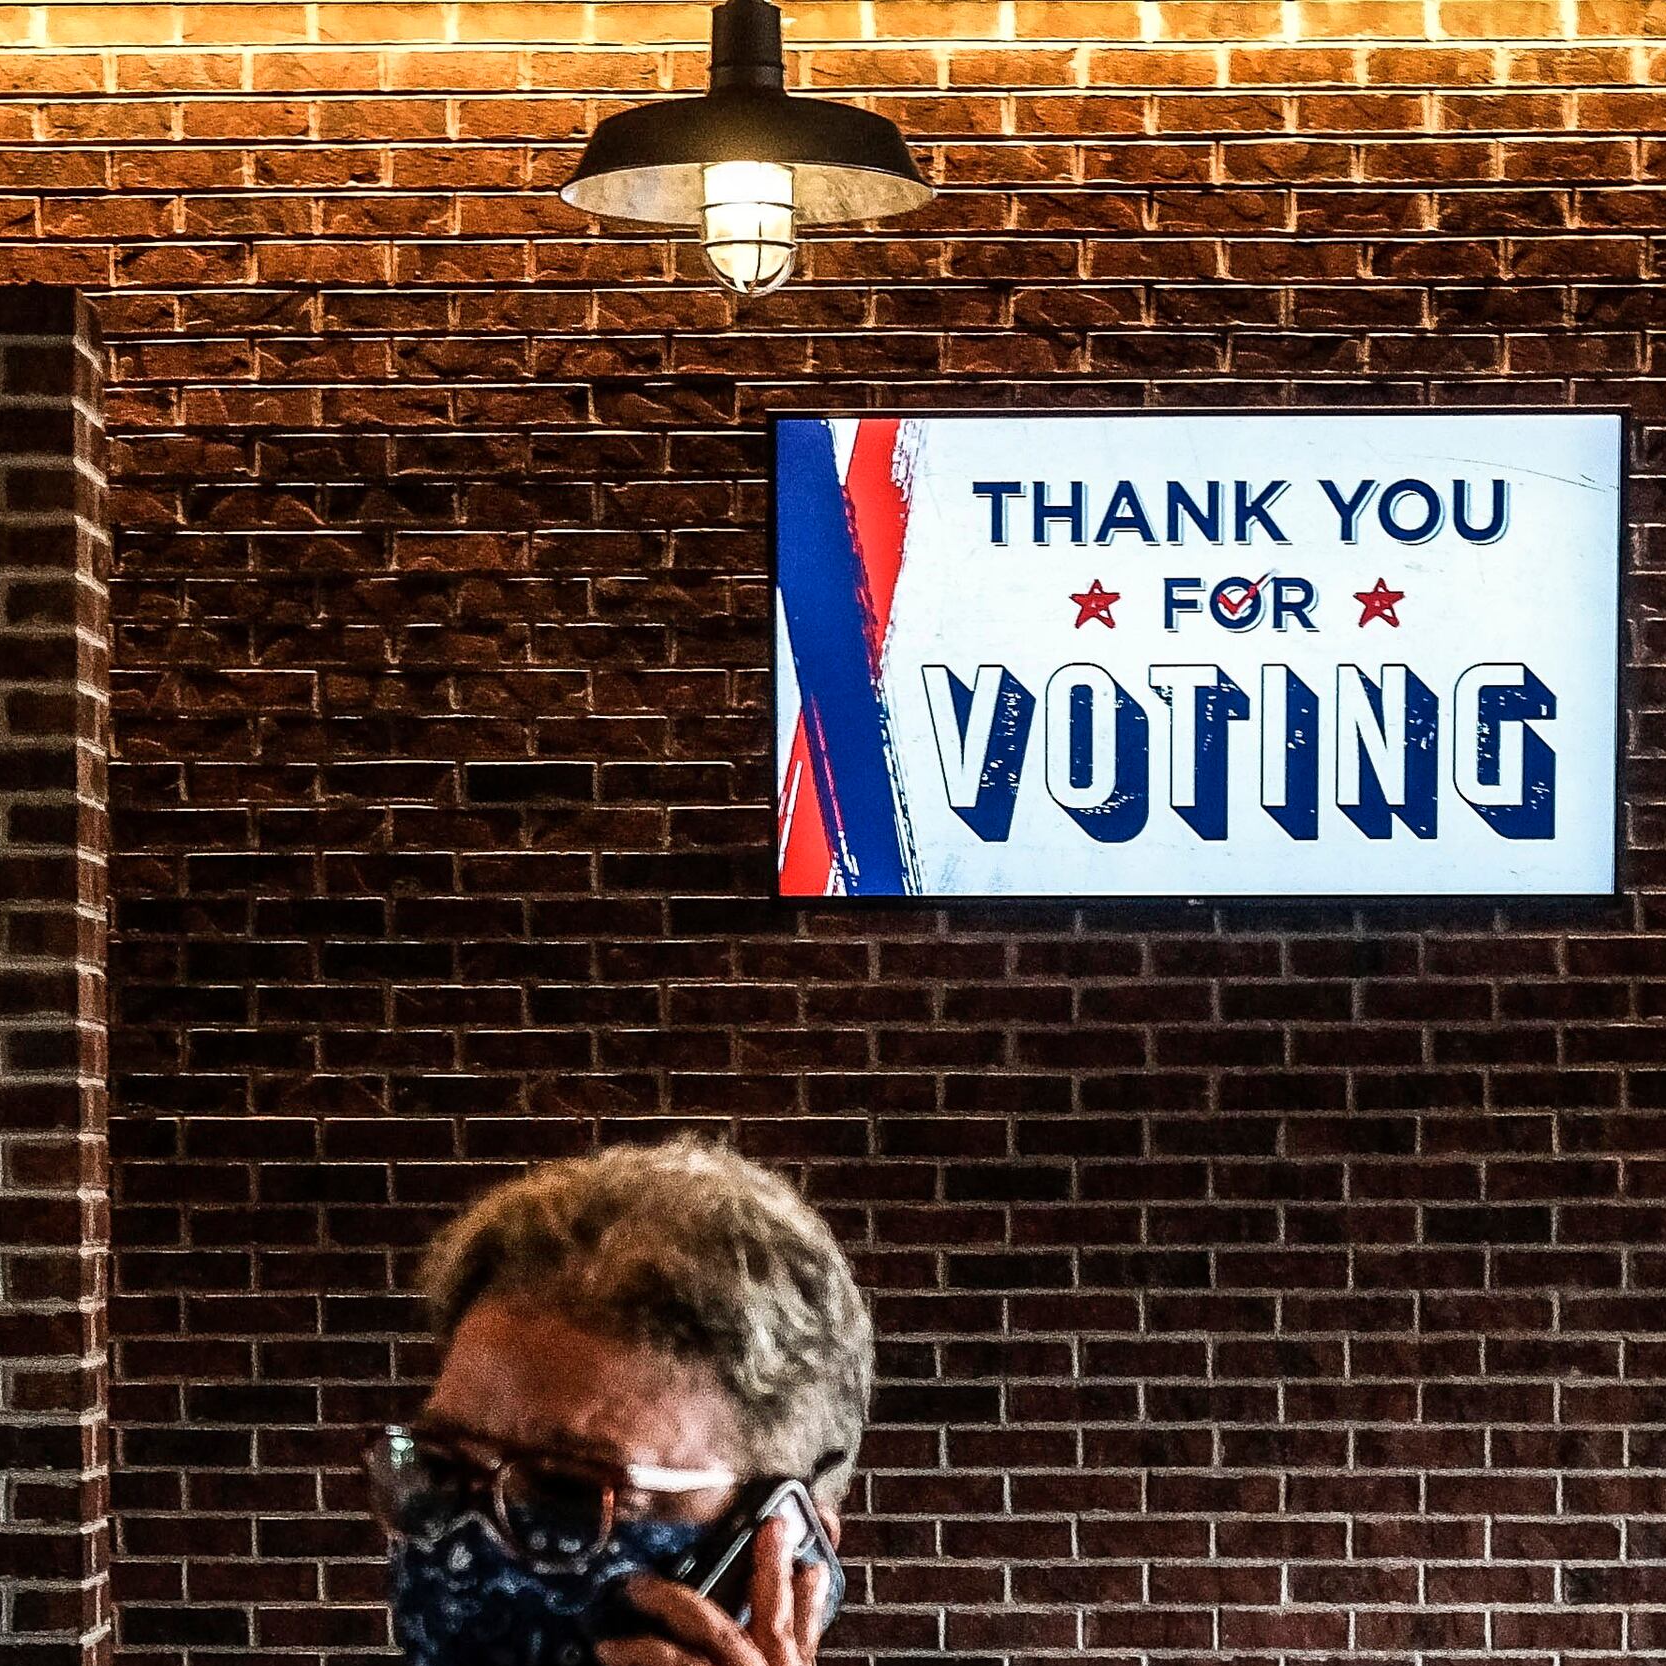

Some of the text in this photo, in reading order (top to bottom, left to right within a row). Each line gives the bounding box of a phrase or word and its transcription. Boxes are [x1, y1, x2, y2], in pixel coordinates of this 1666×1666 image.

[972, 479, 1512, 546] THANK YOU
[1163, 574, 1318, 632] FOR
[921, 662, 1557, 844] VOTING
